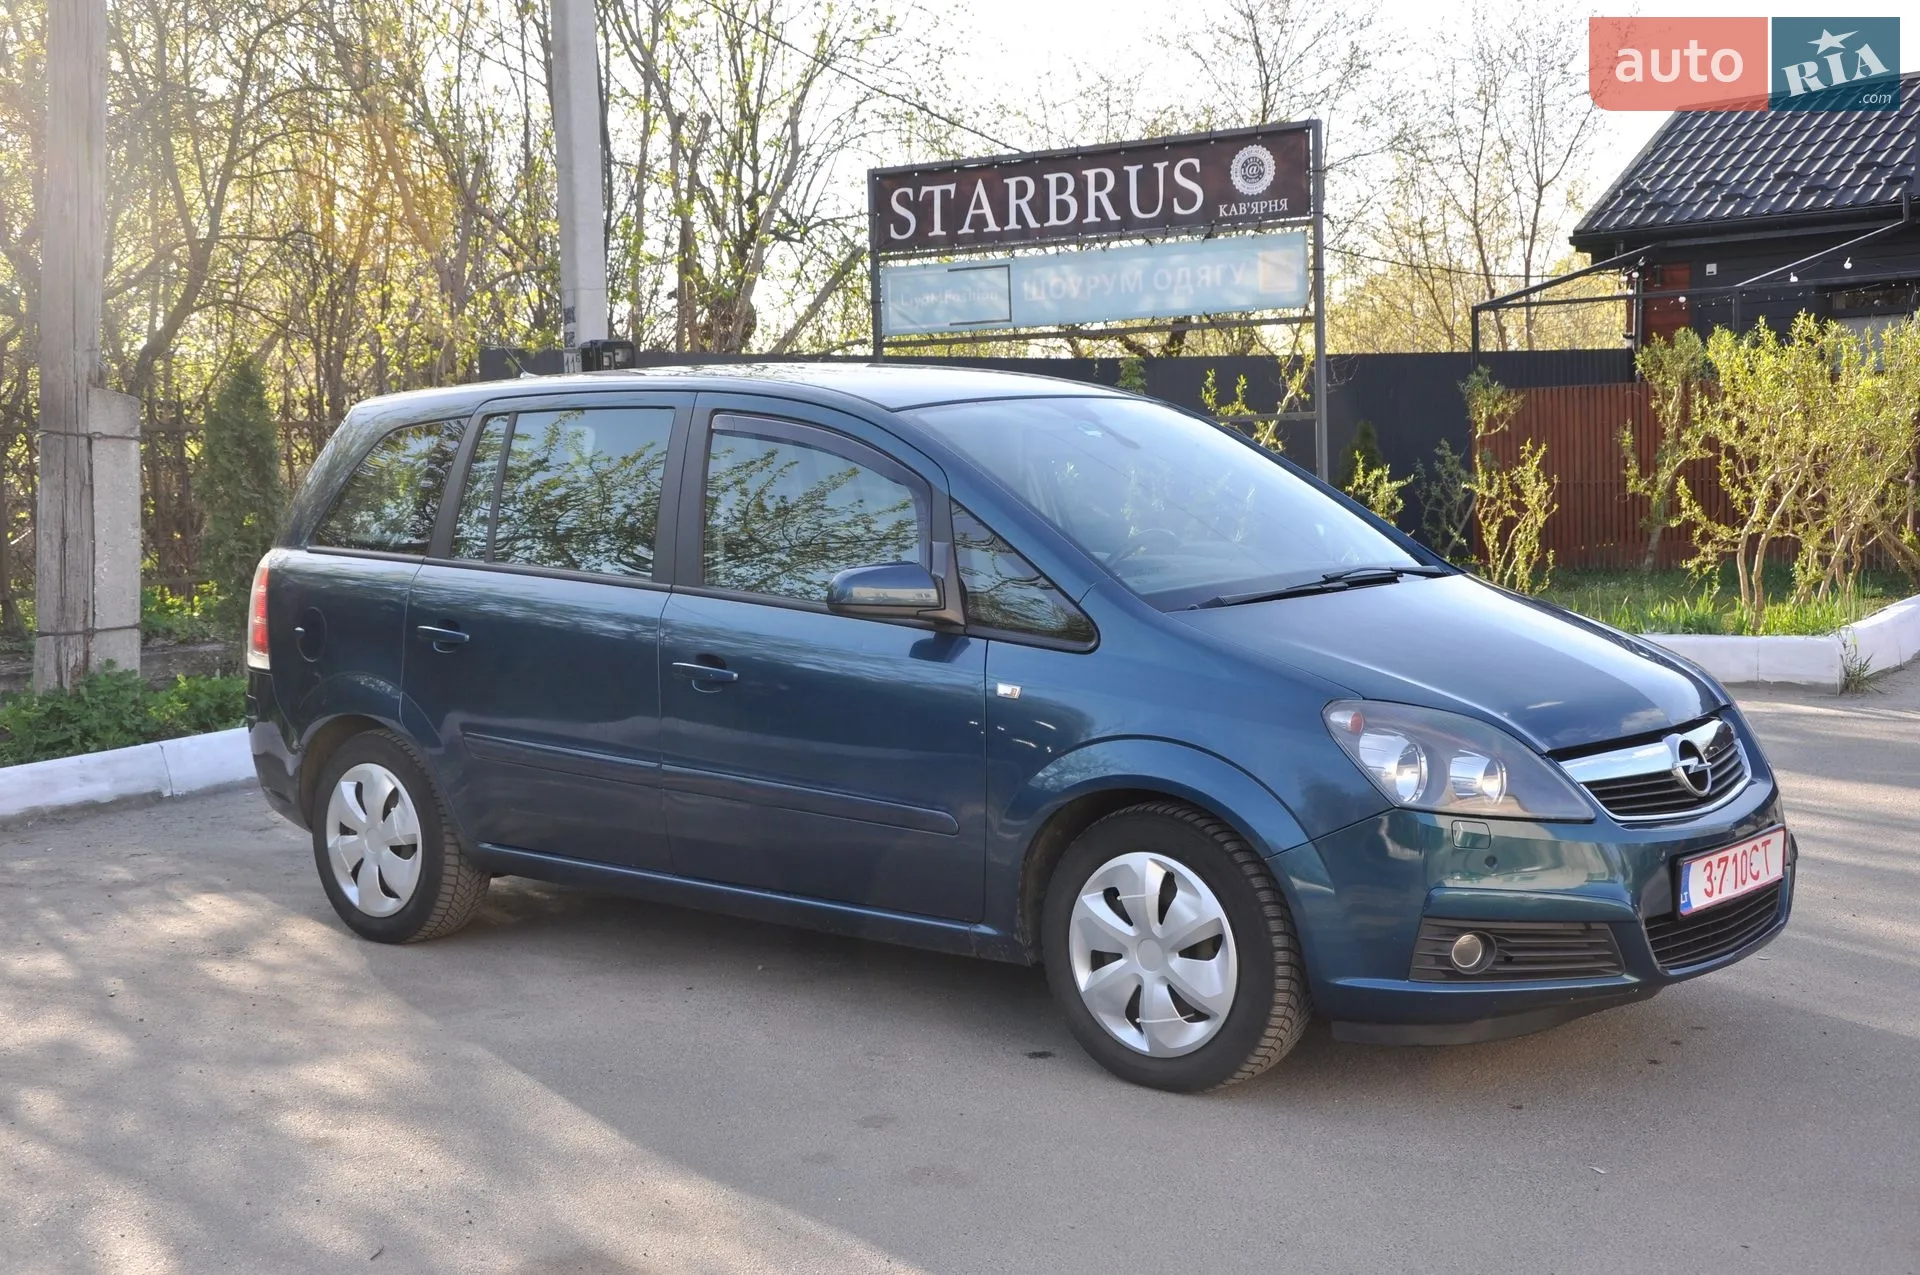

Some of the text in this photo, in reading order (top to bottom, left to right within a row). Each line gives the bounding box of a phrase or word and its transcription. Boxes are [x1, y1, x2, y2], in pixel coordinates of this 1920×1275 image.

[889, 158, 1205, 241] STARBRUS
[1218, 198, 1289, 217] КАВ'ЯРНЯ
[1021, 262, 1247, 301] ШОУРУМ ОДЯГУ
[1703, 838, 1772, 898] 3710CT
[1680, 891, 1689, 904] LT
